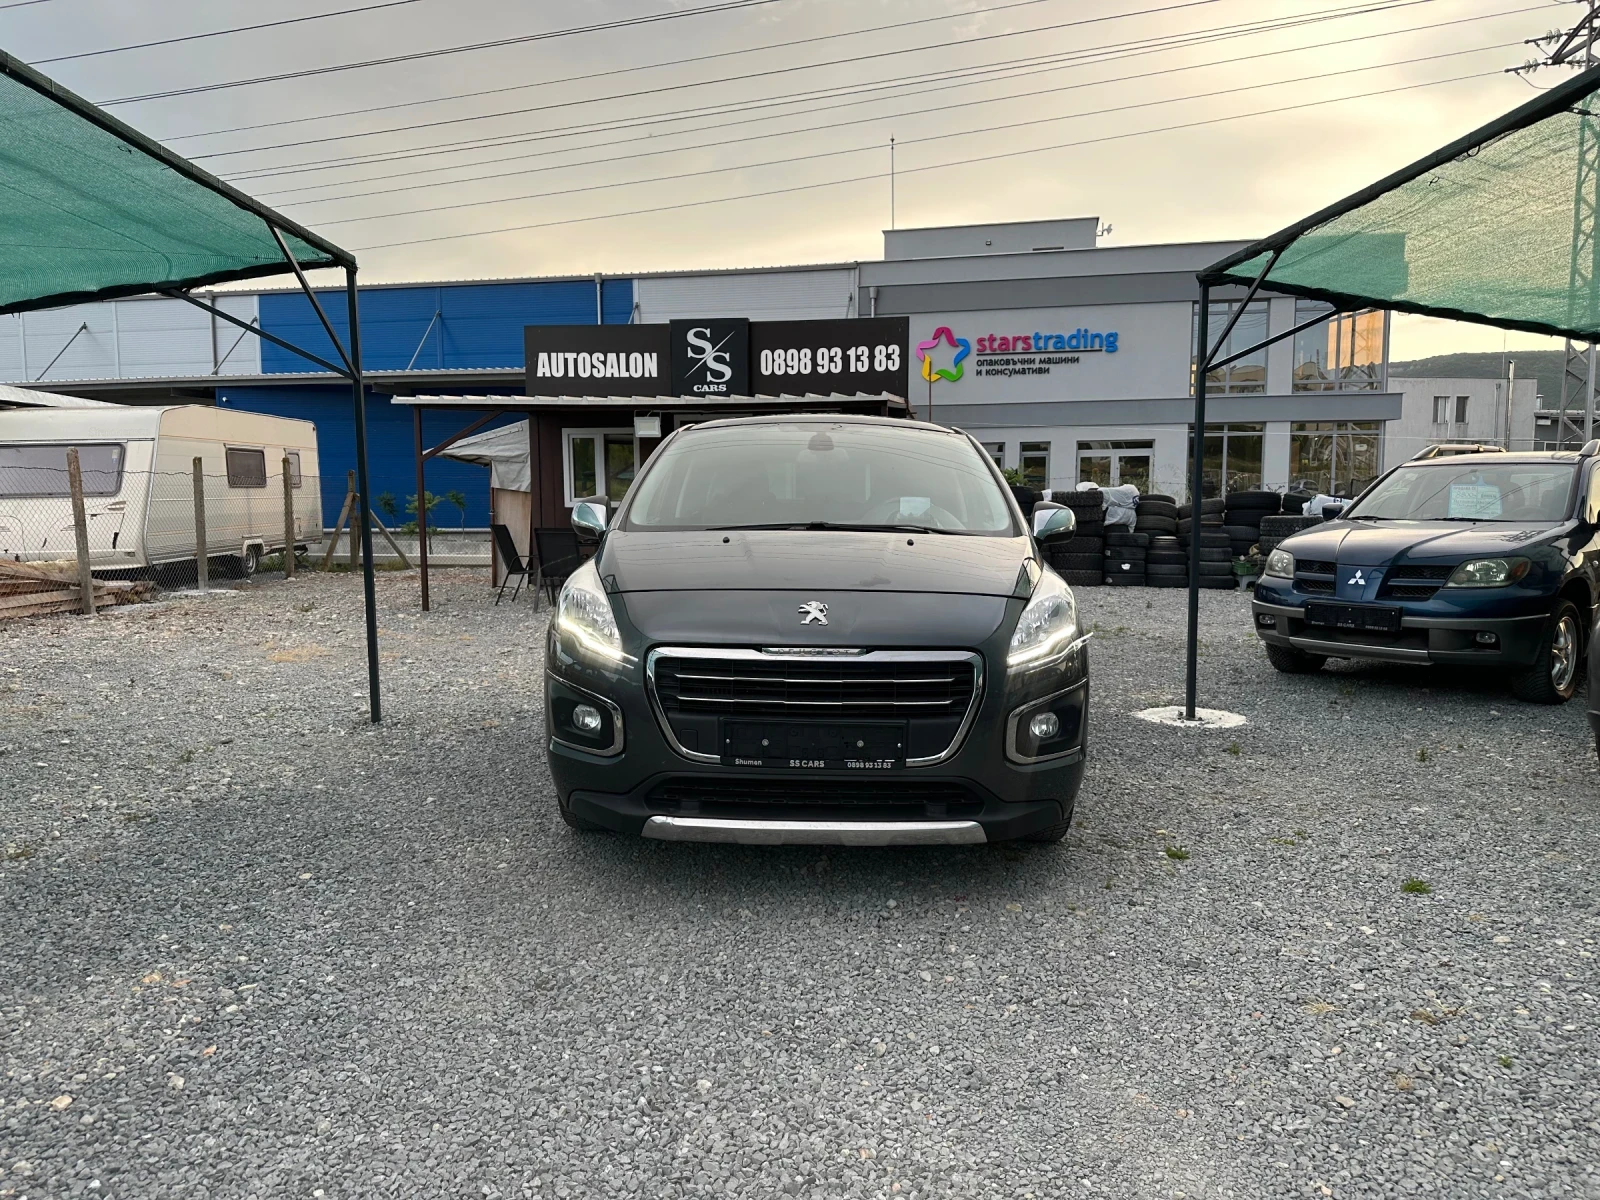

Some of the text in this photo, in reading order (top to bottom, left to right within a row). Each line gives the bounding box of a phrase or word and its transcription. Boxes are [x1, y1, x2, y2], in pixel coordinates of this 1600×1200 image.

[976, 328, 1119, 354] starstrading
[536, 352, 658, 378] AUTOSALON
[760, 344, 901, 376] 0898 93 13 83
[976, 355, 1080, 367] опаковъчни машини
[975, 366, 1050, 378] и консумативи
[693, 383, 727, 393] CARS
[789, 760, 800, 768] SS
[801, 760, 825, 768] CARS
